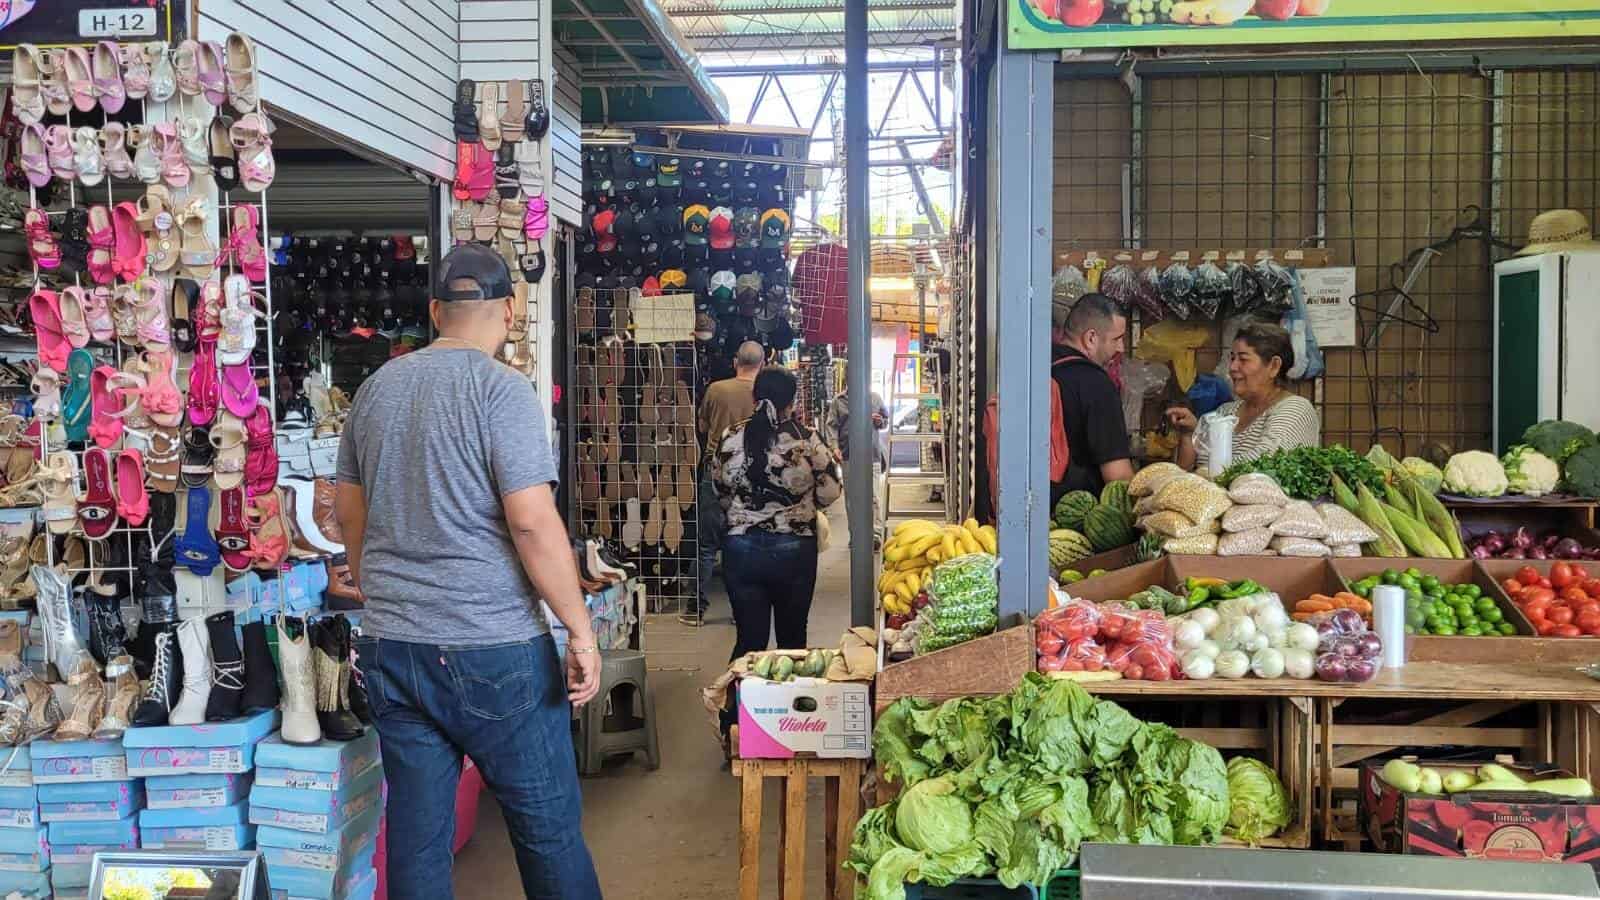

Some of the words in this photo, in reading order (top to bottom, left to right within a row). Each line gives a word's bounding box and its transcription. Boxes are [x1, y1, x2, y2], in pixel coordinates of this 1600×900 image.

[93, 14, 144, 31] H-12
[778, 716, 827, 732] Violeta
[1492, 813, 1537, 823] Tomatoes
